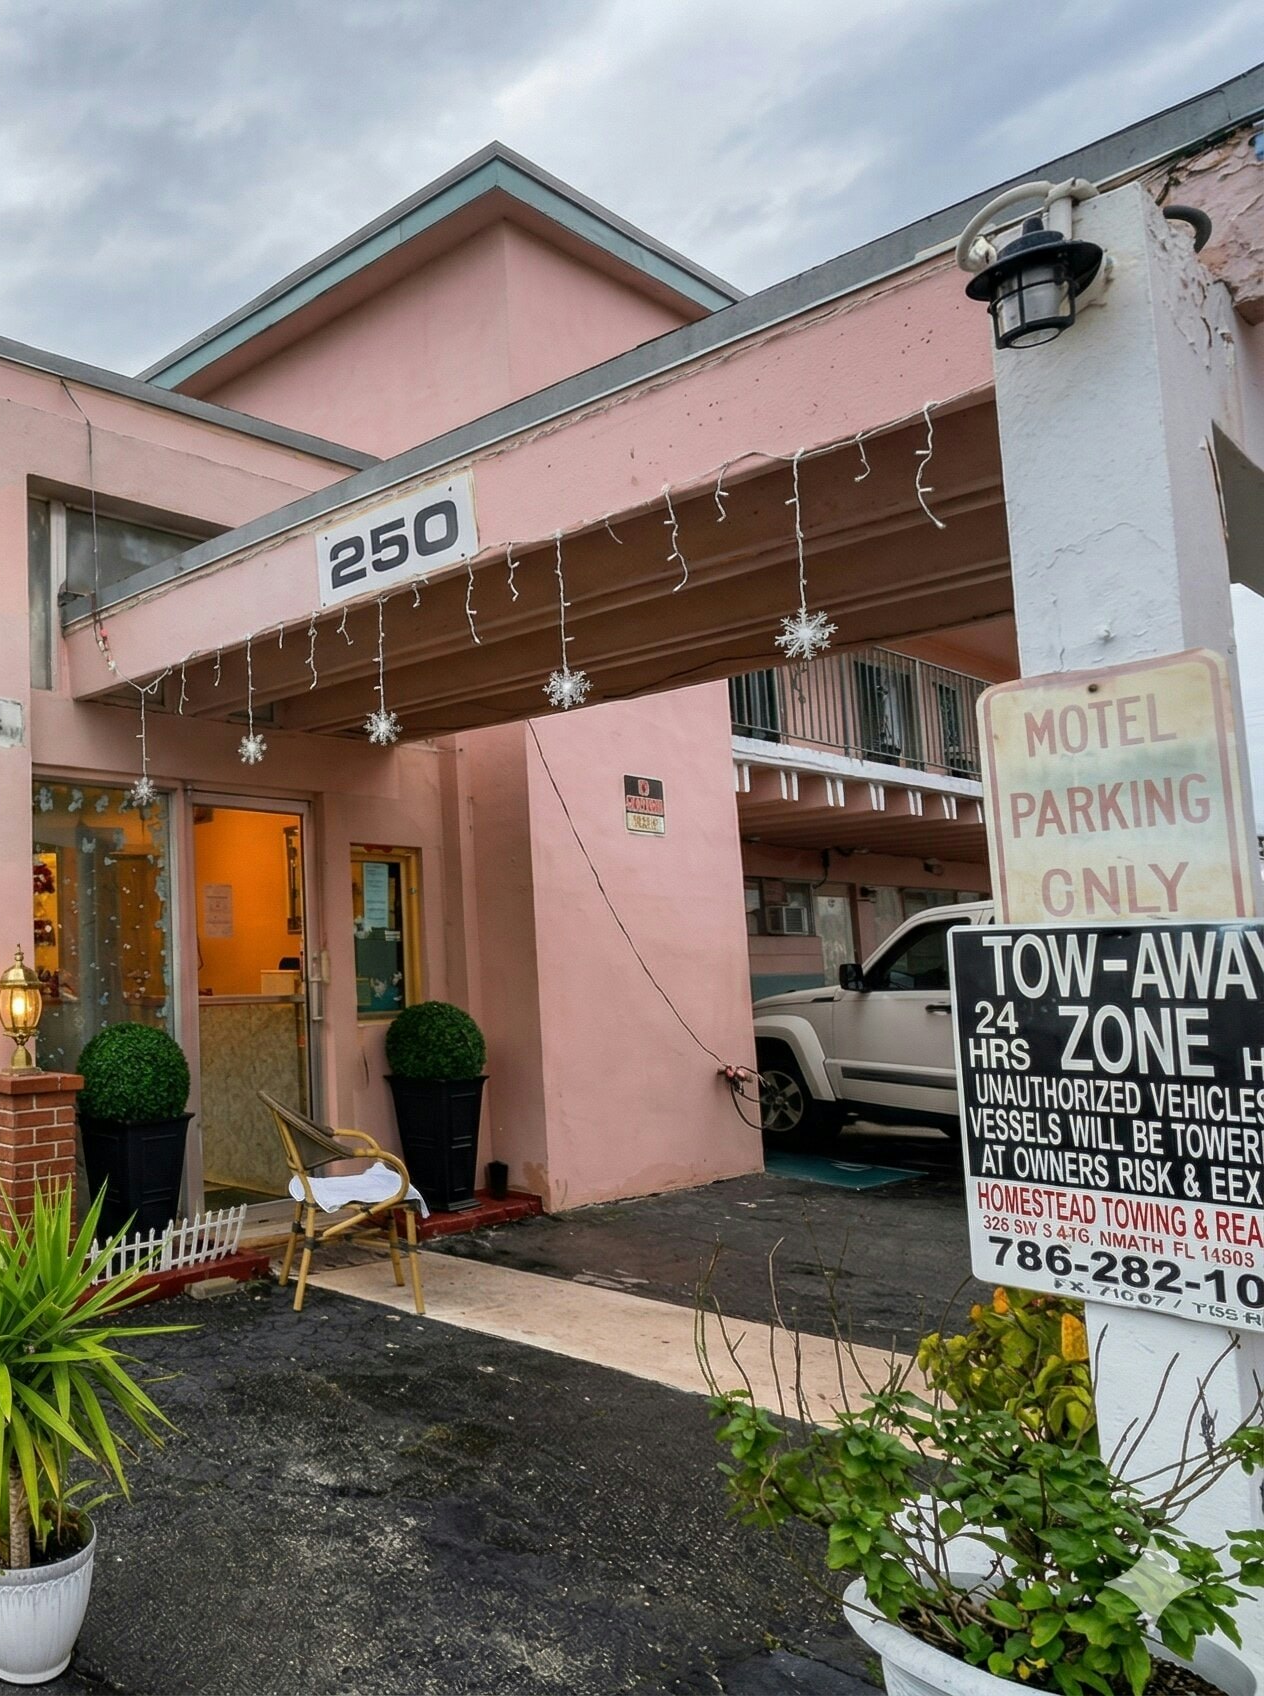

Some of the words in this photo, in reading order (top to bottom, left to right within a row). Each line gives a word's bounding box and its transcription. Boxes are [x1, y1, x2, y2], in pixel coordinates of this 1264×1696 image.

[330, 500, 459, 589] 250
[1024, 693, 1178, 758] MOTEL
[1010, 773, 1211, 839] PARKING
[1041, 862, 1189, 917] ONLY
[975, 1001, 1019, 1034] 24
[1058, 1004, 1215, 1077] ZONE
[968, 1038, 1031, 1070] HRS
[976, 1073, 1141, 1114] UNAUTHORIZED
[969, 1107, 1062, 1145] VESSELS
[1069, 1114, 1124, 1151] WILL
[1132, 1120, 1164, 1155] BE
[1171, 1123, 1264, 1165] TOWER
[981, 1144, 1006, 1175] AT
[1014, 1146, 1109, 1187] OWNERS
[1118, 1157, 1175, 1195] RISK
[1183, 1163, 1201, 1198] &
[977, 1181, 1096, 1225] HOMESTEAD
[1101, 1197, 1187, 1237] TOWING
[1194, 1208, 1209, 1240] &
[1173, 1241, 1195, 1260] FL
